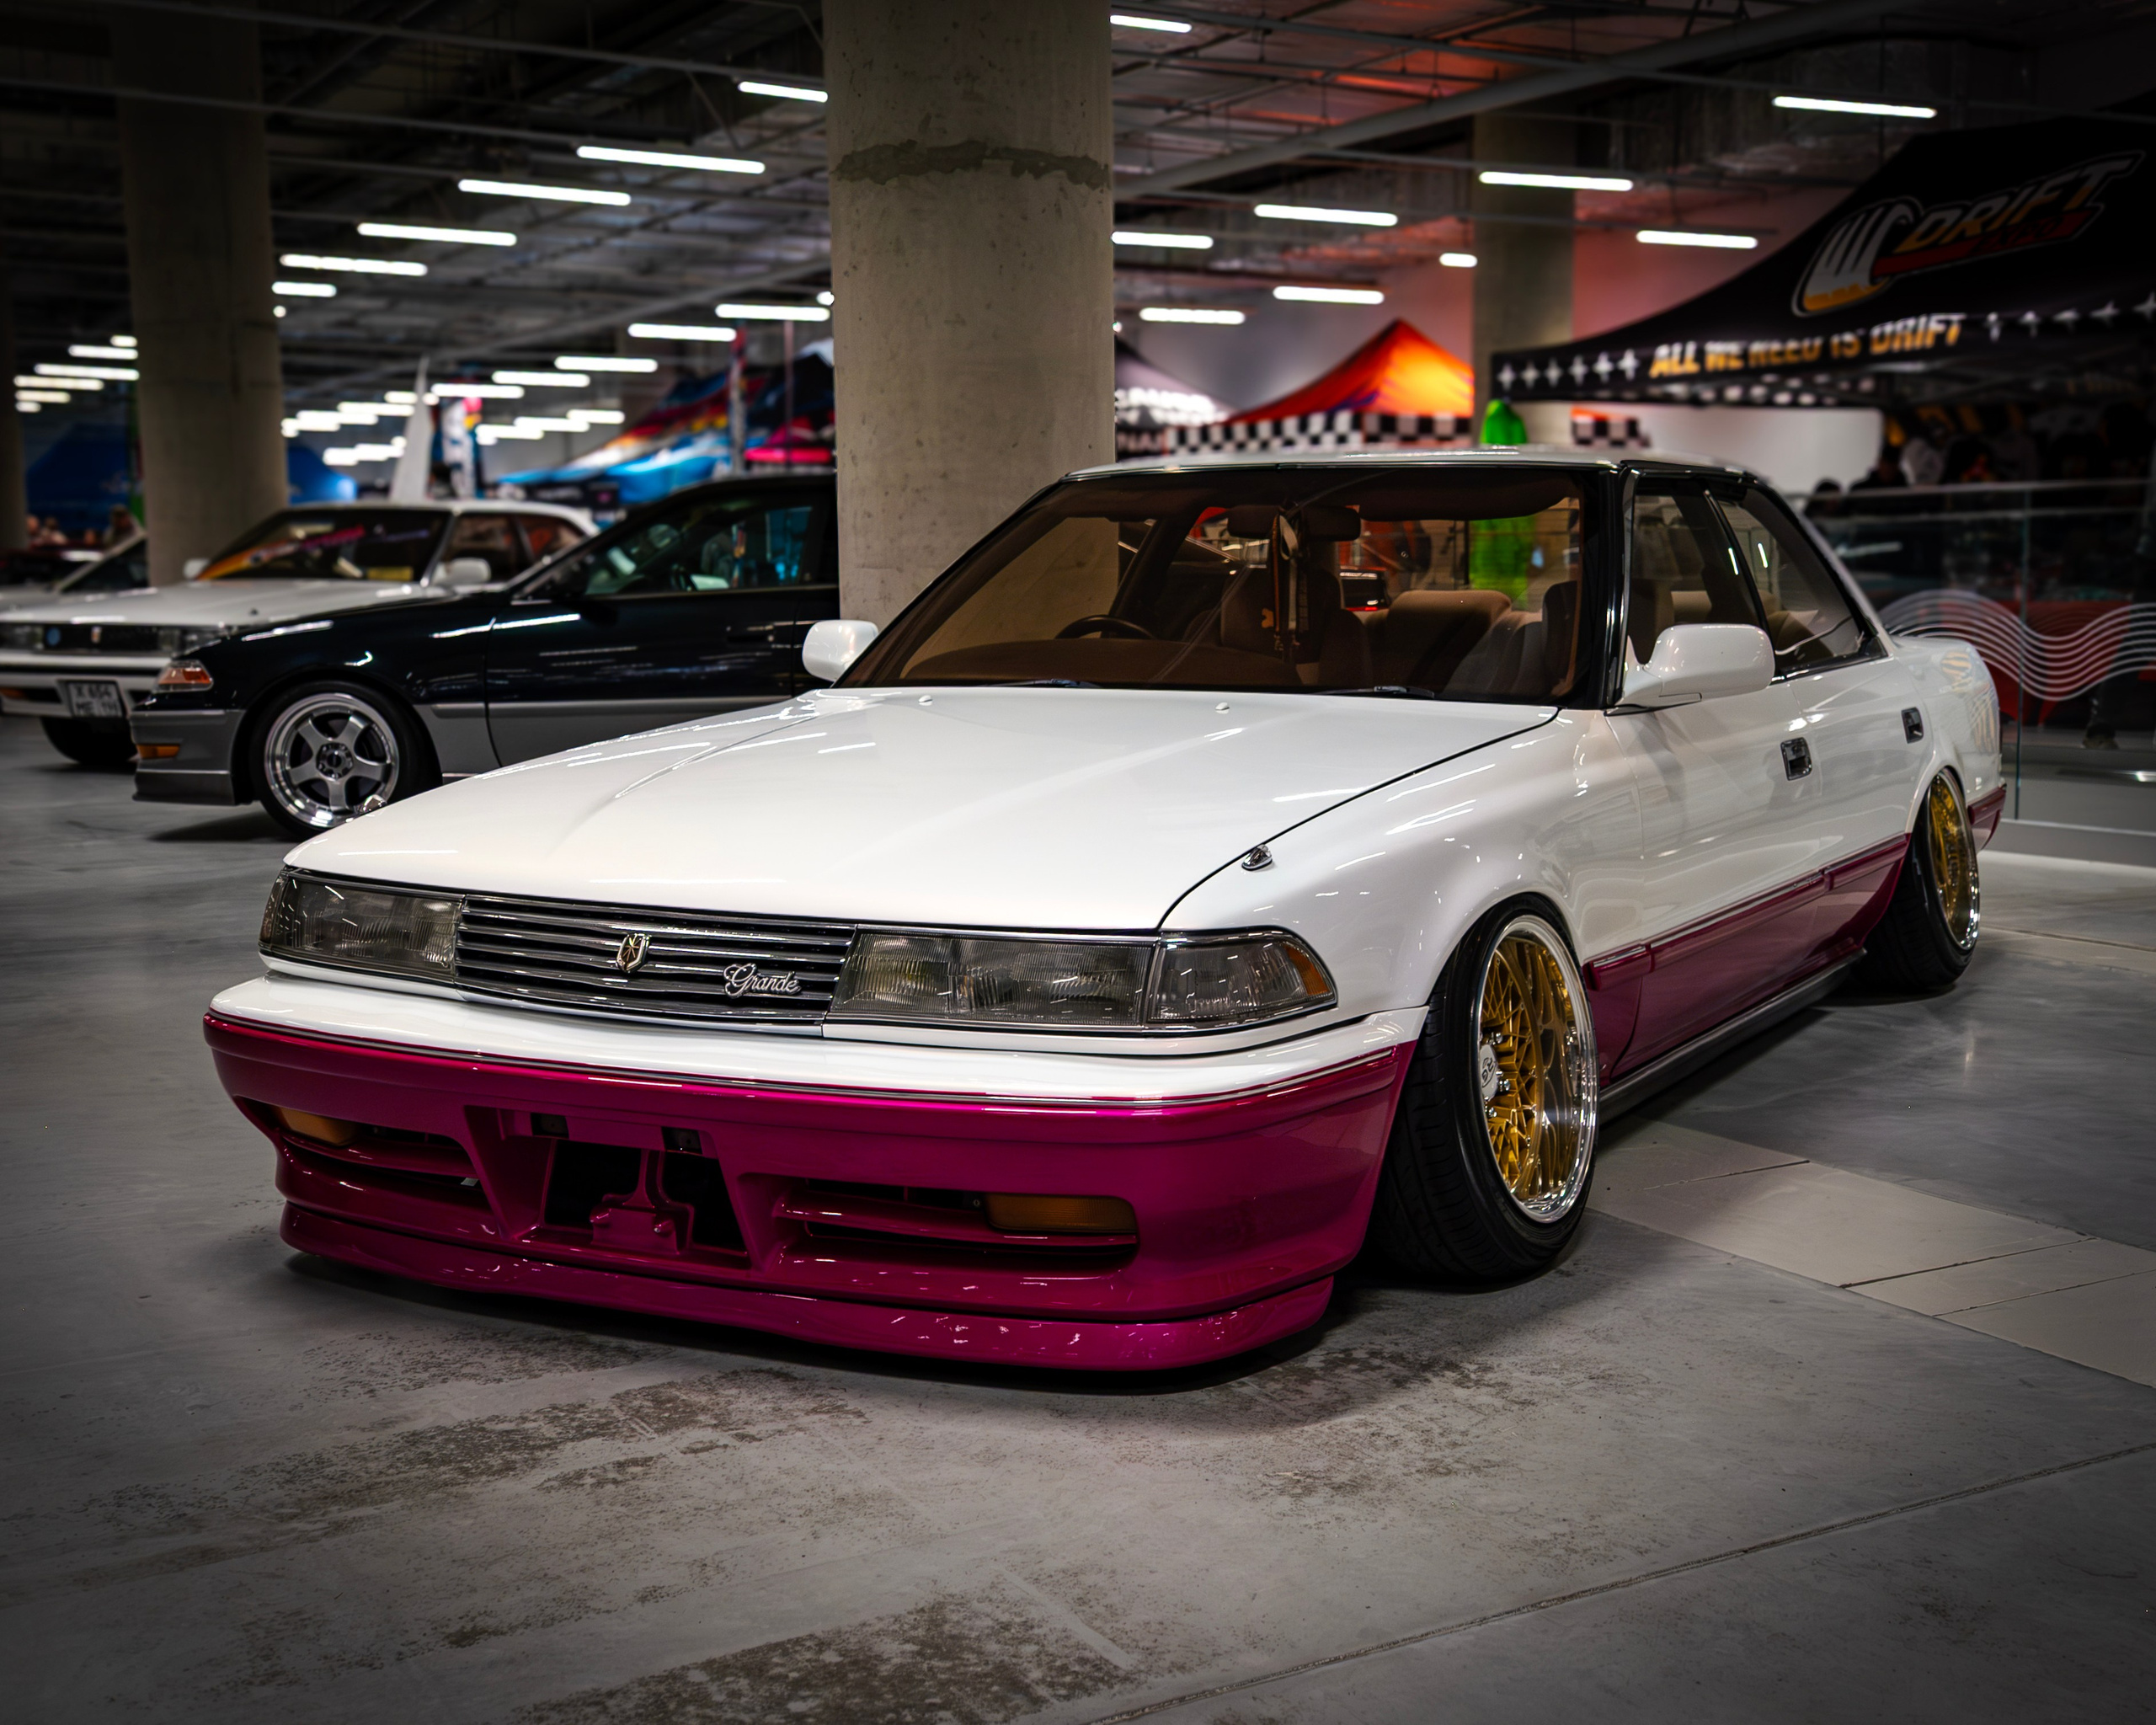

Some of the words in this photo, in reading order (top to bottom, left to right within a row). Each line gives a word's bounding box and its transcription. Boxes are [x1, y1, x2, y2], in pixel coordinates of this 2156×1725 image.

[1893, 157, 2135, 254] DRIFT
[1649, 340, 1700, 378] ALL
[1705, 340, 1745, 371] WE
[1748, 336, 1823, 368] NEED
[1831, 332, 1863, 360] IS
[1870, 312, 1967, 355] DRIFT
[723, 962, 802, 999] Grande
